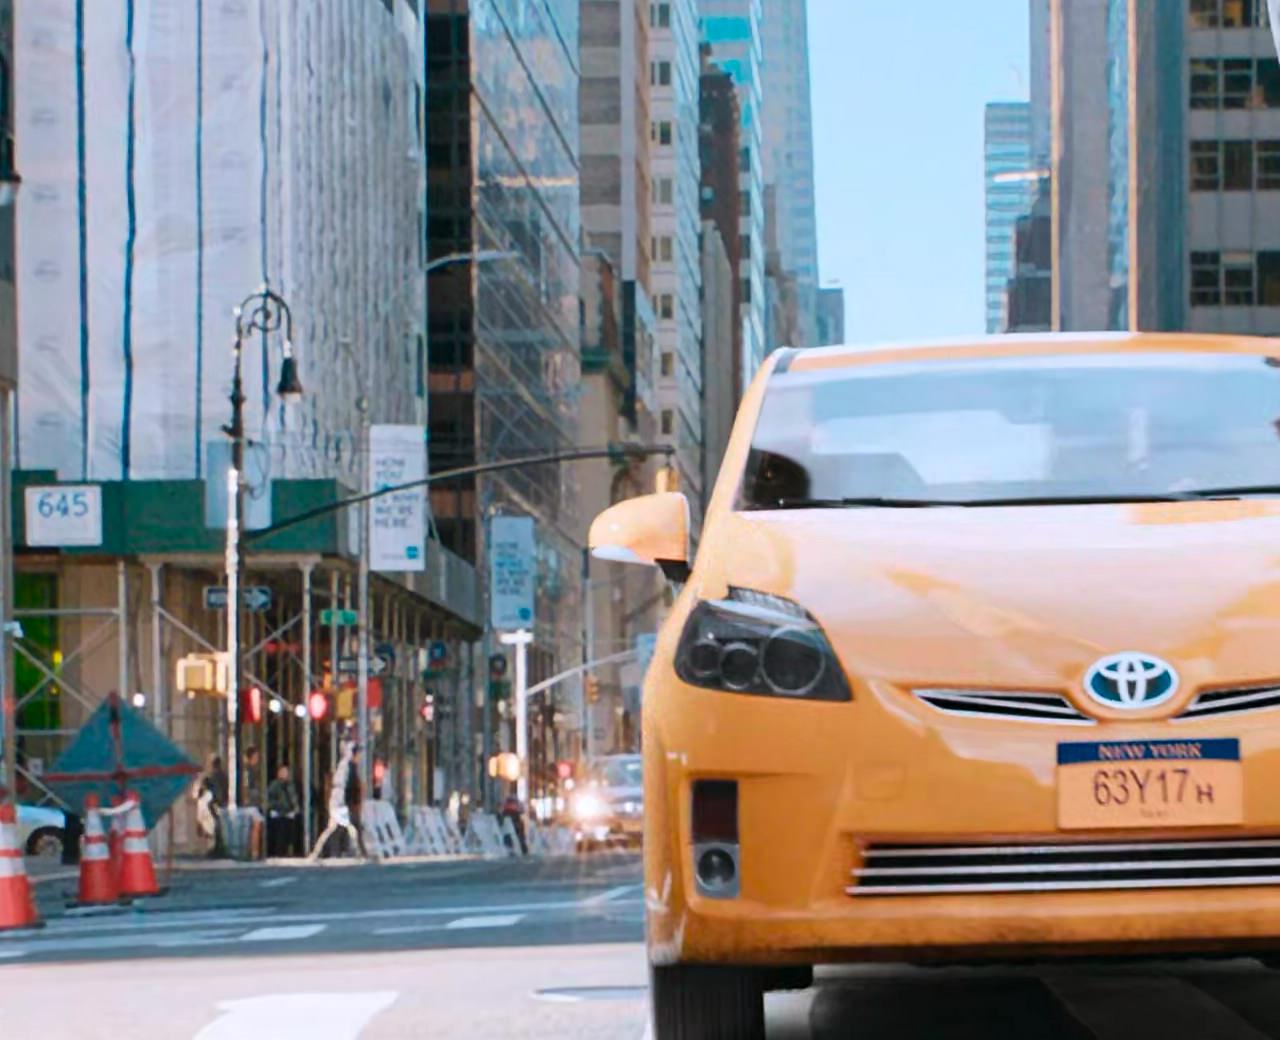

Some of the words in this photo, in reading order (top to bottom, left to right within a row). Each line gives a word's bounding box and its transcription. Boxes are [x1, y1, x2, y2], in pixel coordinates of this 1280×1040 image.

[37, 491, 89, 518] 645
[1097, 744, 1146, 760] NEW
[1148, 742, 1203, 758] YORK
